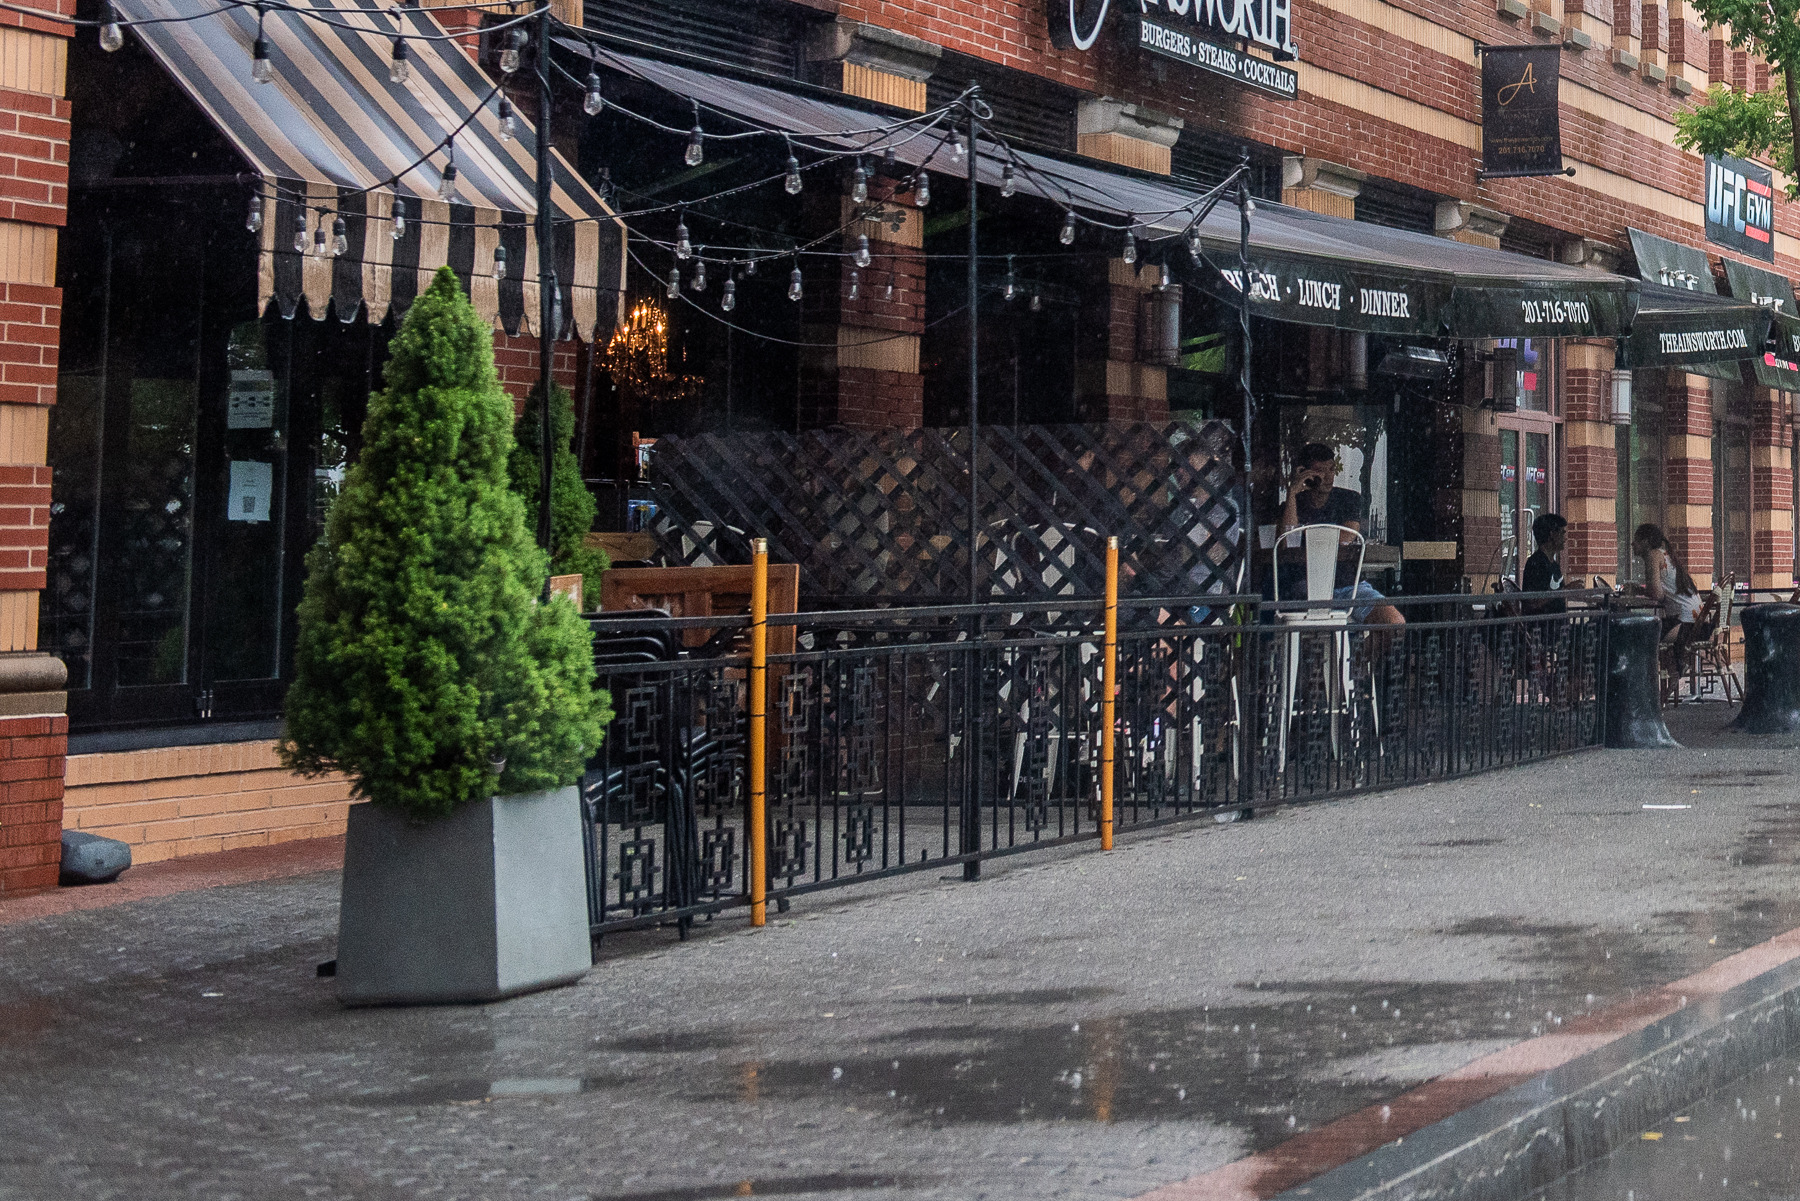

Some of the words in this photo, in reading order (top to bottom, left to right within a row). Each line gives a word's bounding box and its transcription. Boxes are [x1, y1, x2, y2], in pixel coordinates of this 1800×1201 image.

[1140, 20, 1191, 58] BURGERS
[1198, 41, 1237, 74] STEAKS
[1243, 58, 1296, 95] COCKTAILS
[1708, 161, 1748, 233] UFC
[1746, 193, 1772, 230] GYM
[1297, 278, 1341, 311] LUNCH
[1360, 288, 1411, 318] DINNER
[1521, 300, 1590, 324] 201-716-7070
[1659, 329, 1748, 354] THEAINSWORTH.COM
